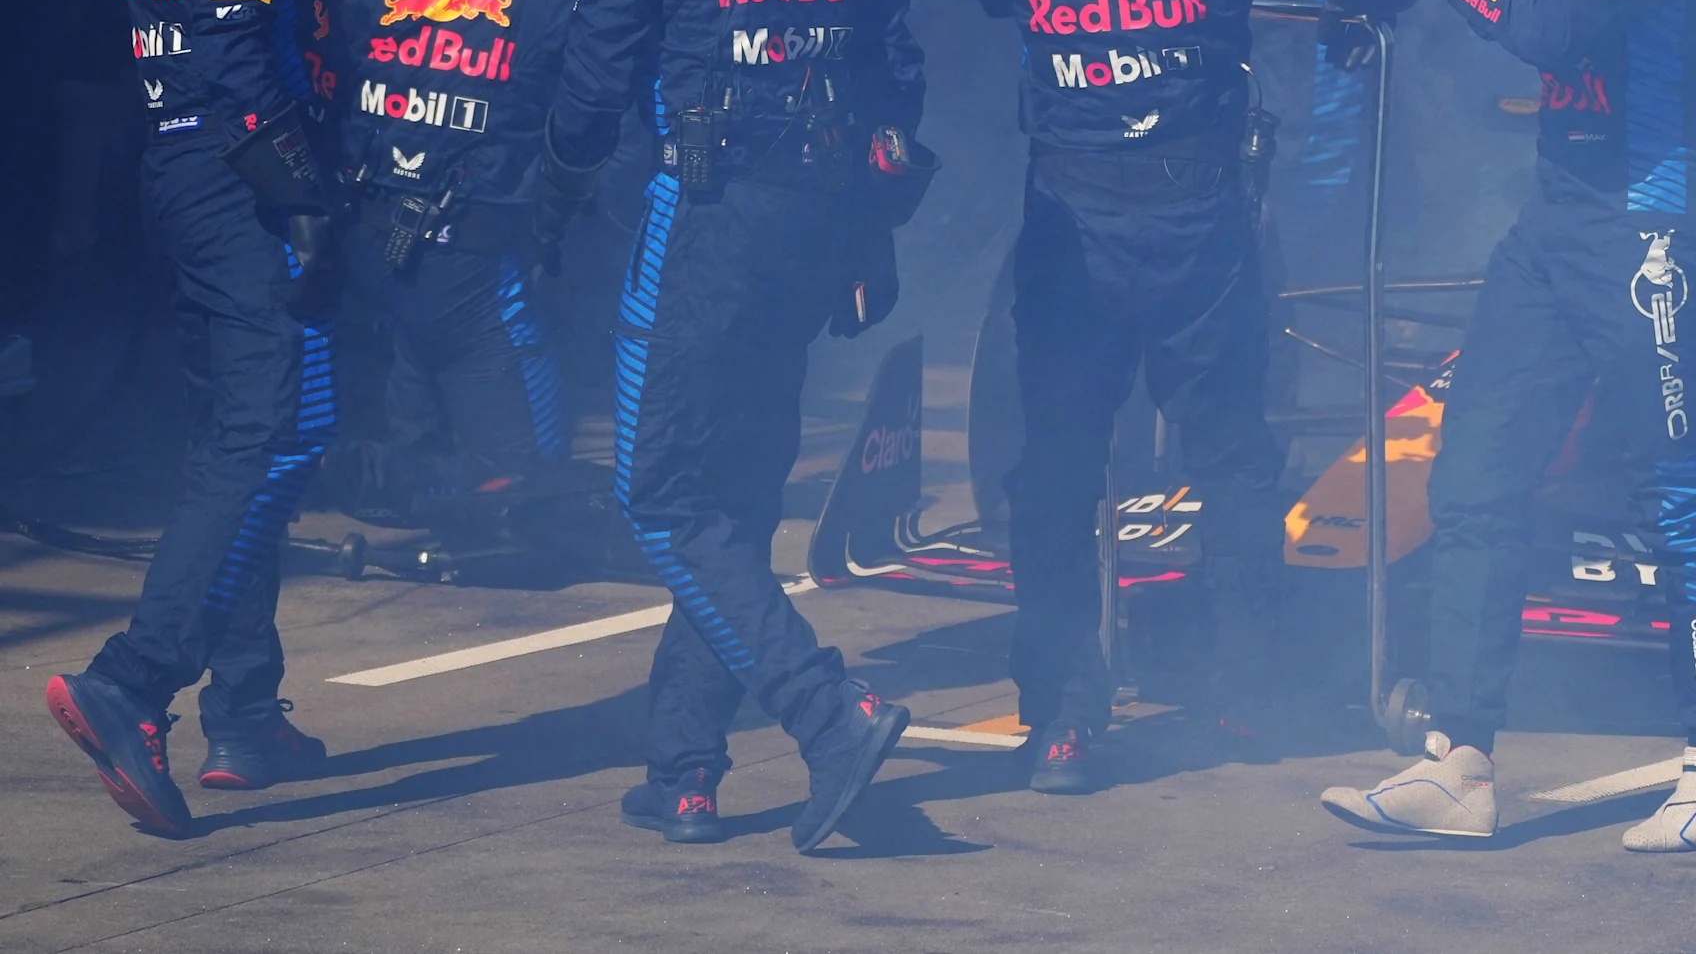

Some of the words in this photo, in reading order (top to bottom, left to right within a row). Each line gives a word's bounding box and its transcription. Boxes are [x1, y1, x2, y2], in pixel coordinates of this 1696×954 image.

[1477, 0, 1501, 24] Bull
[732, 26, 825, 66] Mobil
[1051, 45, 1163, 89] Mobil
[360, 79, 448, 127] Mobil
